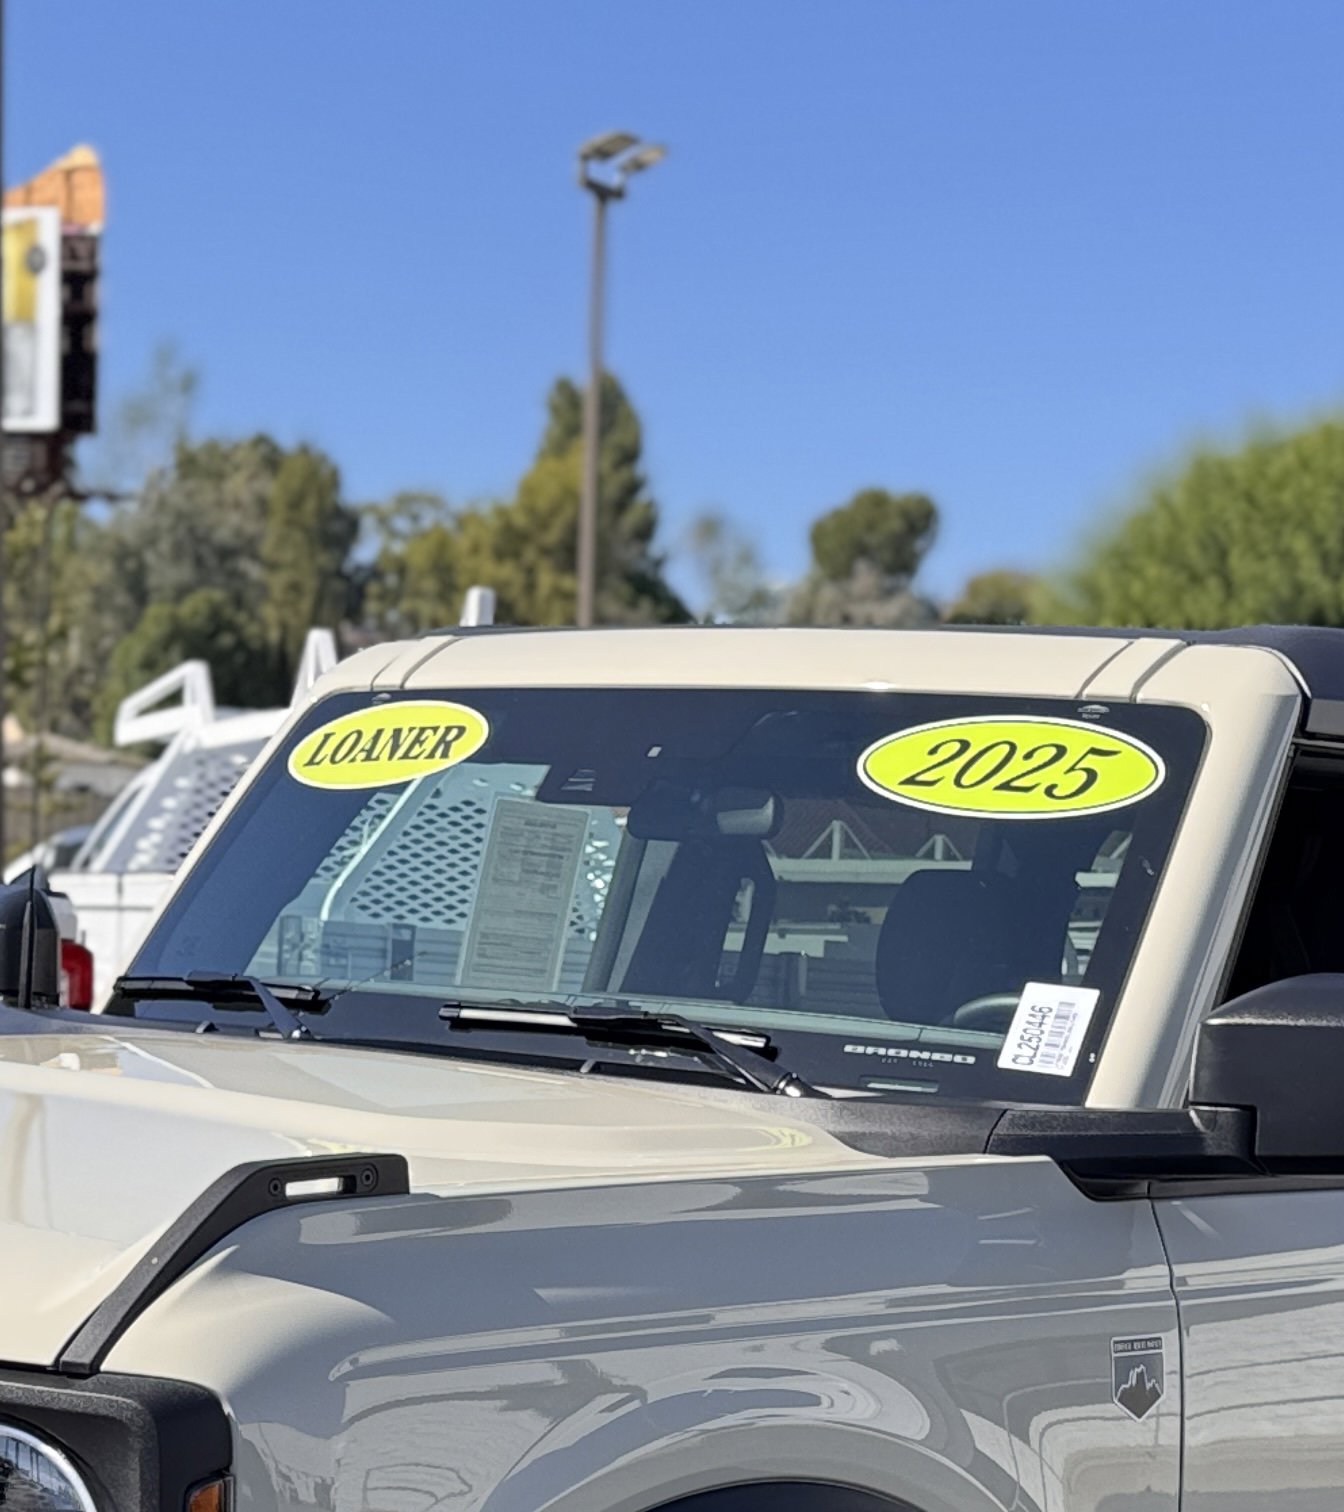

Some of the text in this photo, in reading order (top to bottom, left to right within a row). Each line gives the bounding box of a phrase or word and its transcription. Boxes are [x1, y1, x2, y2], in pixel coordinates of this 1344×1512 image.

[303, 725, 467, 767] LOANER
[897, 738, 1123, 801] 2025
[1012, 1004, 1053, 1066] CL250446
